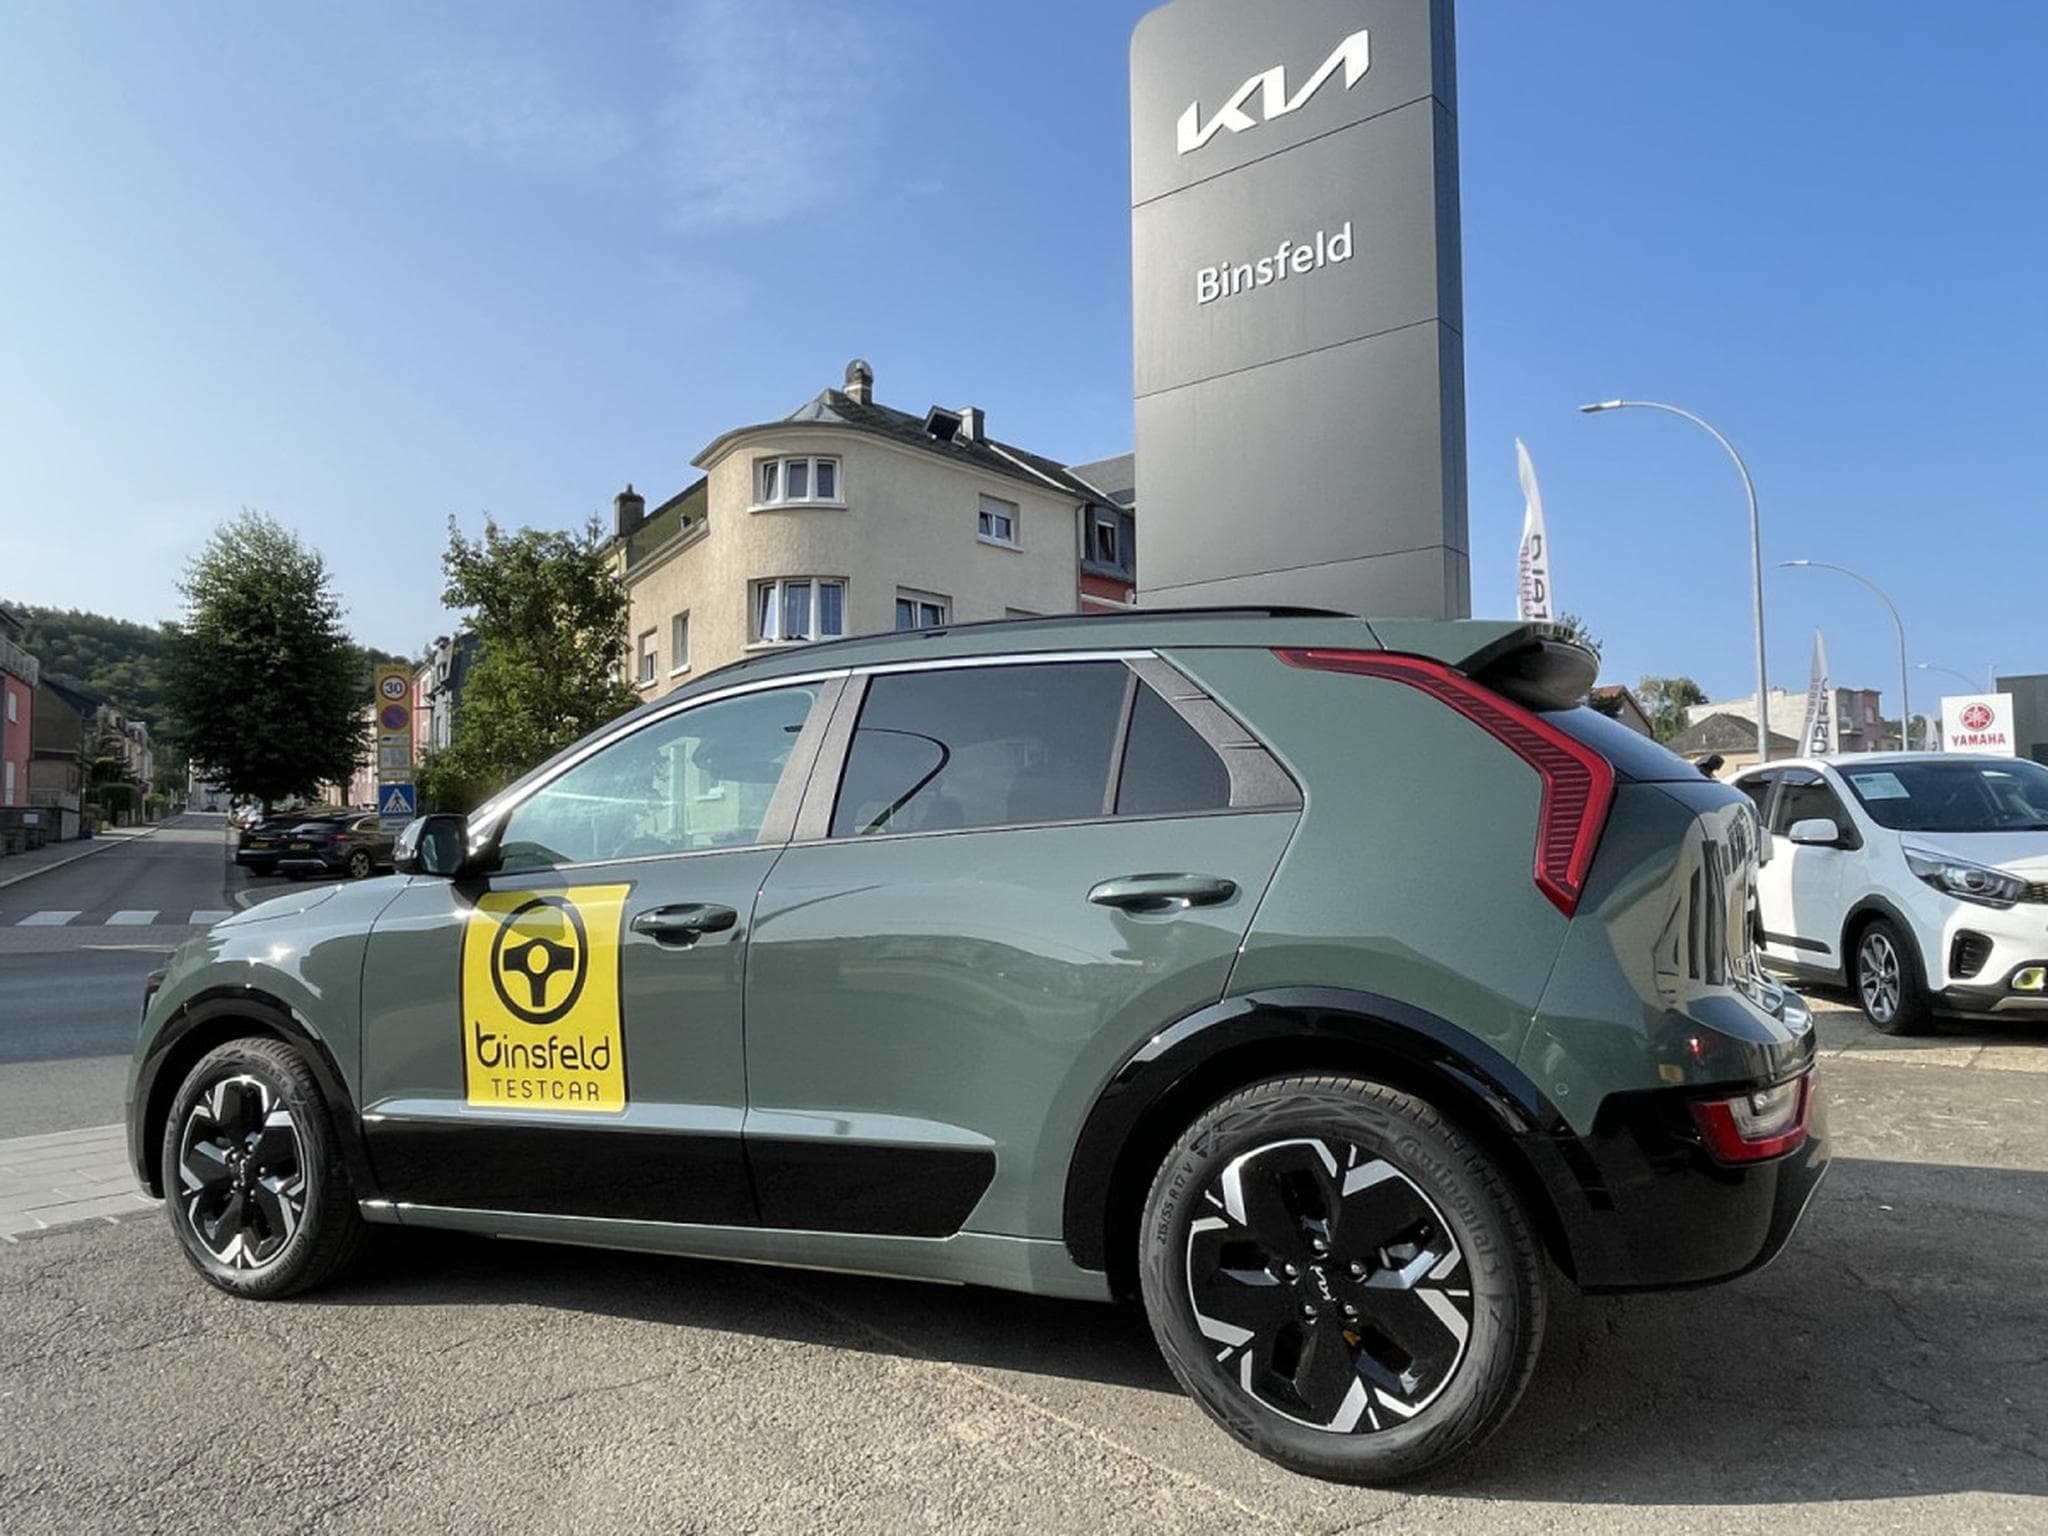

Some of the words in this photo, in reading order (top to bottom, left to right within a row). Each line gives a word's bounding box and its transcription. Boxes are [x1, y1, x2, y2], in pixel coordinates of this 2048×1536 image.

[1177, 29, 1369, 156] KIA
[1197, 221, 1353, 304] Binsfeld
[385, 682, 404, 695] 30
[1951, 732, 2006, 747] YAMAHA
[475, 1020, 611, 1071] binsfeld
[491, 1078, 600, 1101] TESTCAR
[1182, 1161, 1194, 1174] V
[1174, 1173, 1187, 1189] 17
[1168, 1187, 1181, 1201] R
